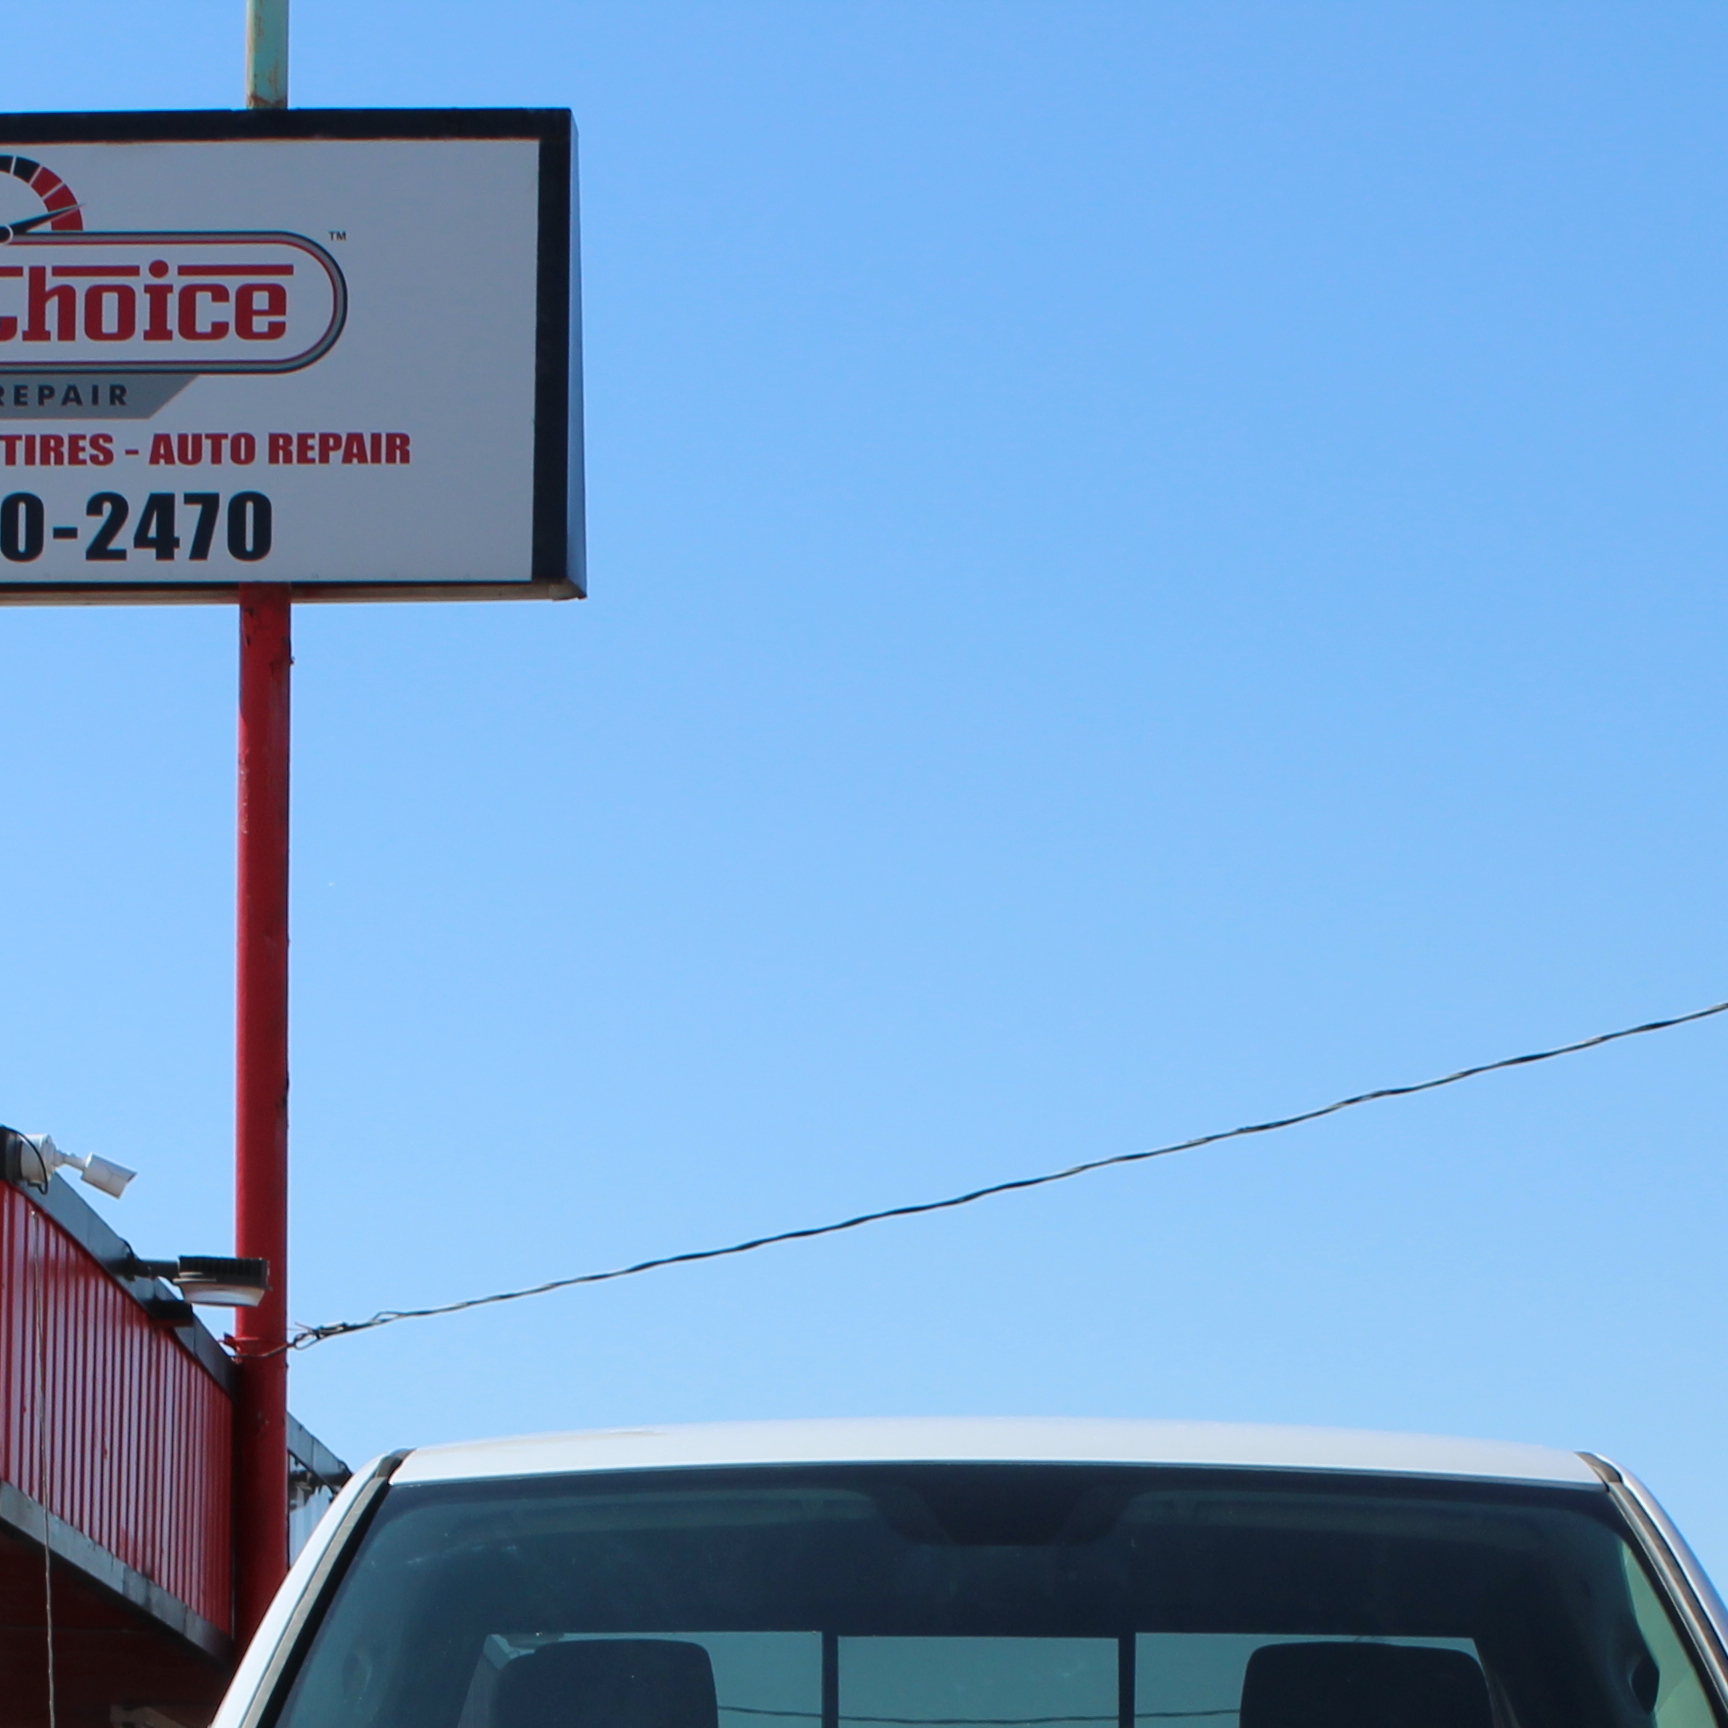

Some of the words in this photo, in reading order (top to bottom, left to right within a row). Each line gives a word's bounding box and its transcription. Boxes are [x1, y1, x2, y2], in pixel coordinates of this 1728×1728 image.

[0, 433, 114, 466] TIRES
[148, 433, 256, 466] AUTO
[268, 432, 411, 465] REPAIR
